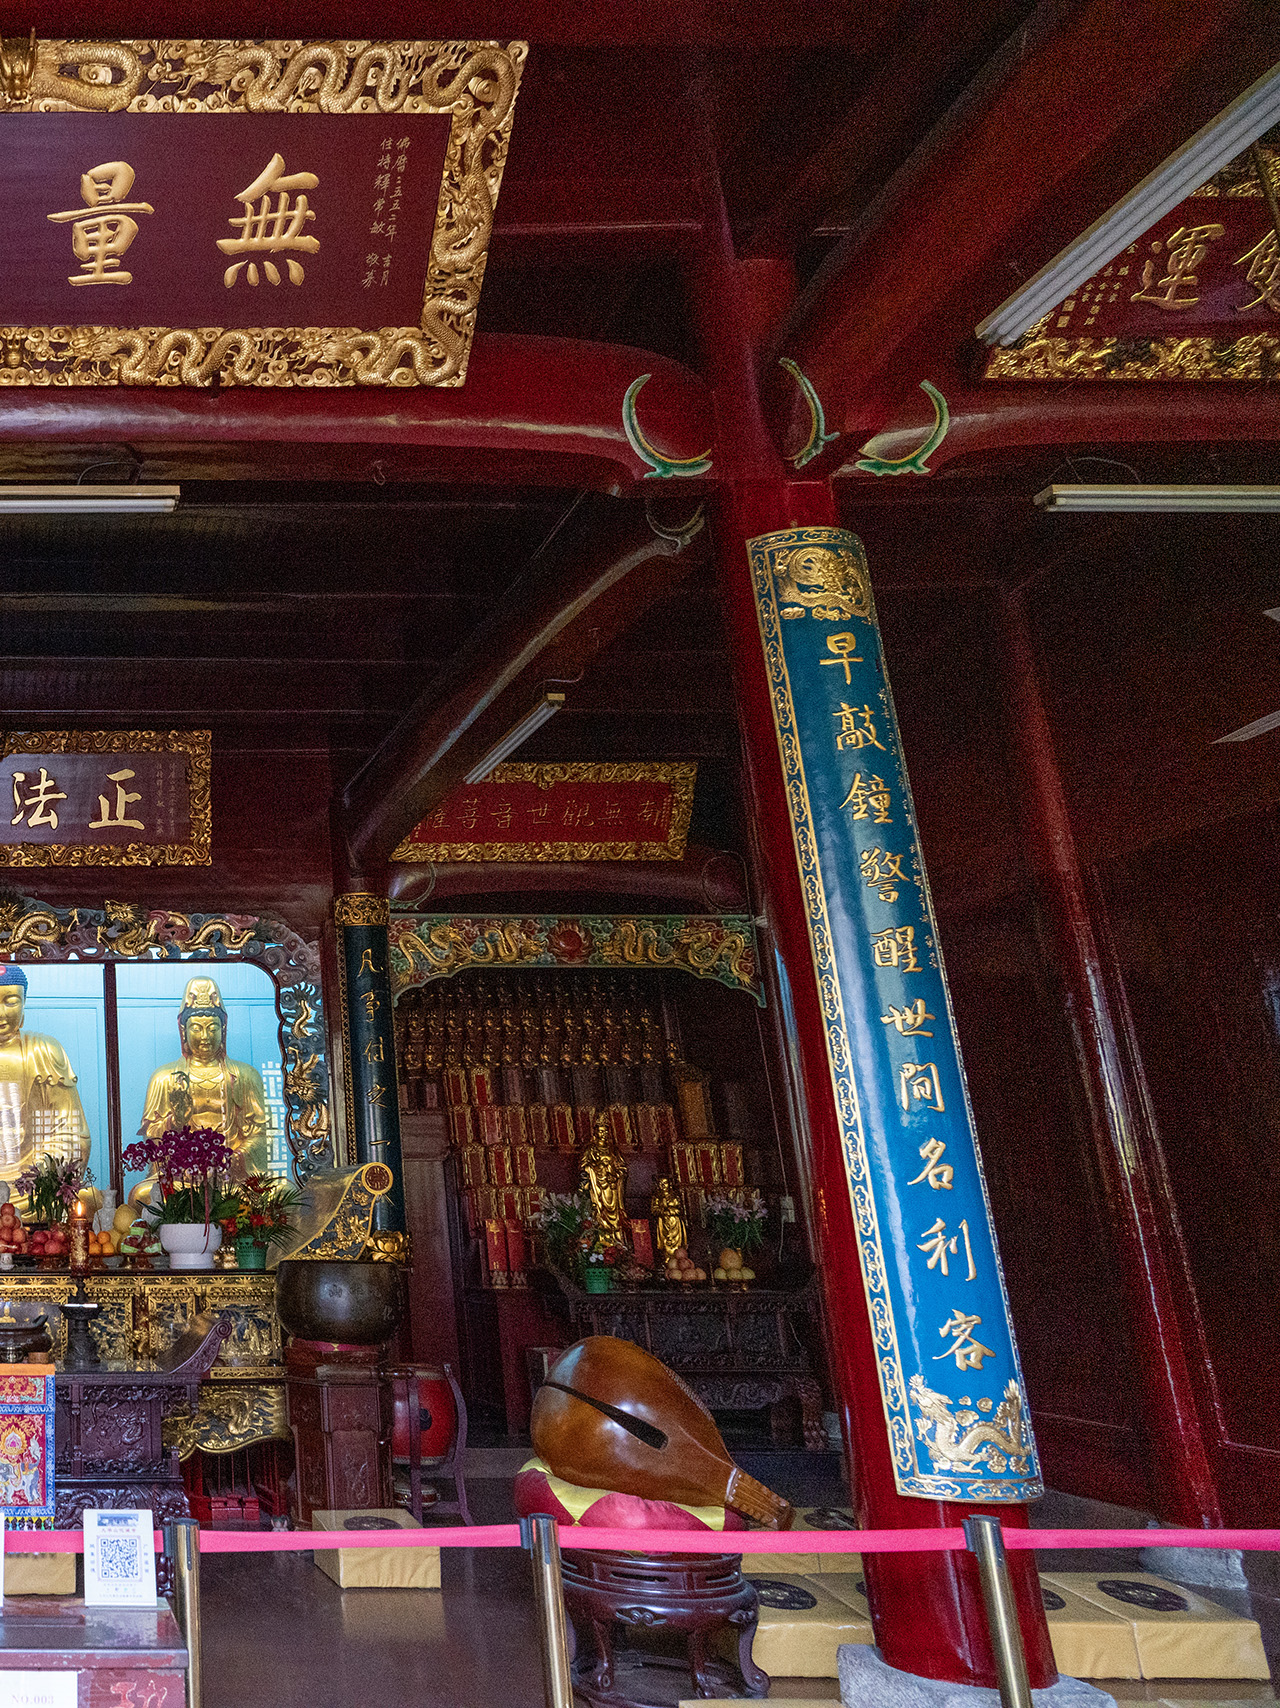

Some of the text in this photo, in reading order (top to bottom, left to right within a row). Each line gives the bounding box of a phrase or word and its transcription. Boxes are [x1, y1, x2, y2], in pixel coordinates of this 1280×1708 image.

[356, 948, 395, 1206] 凡事付之一
